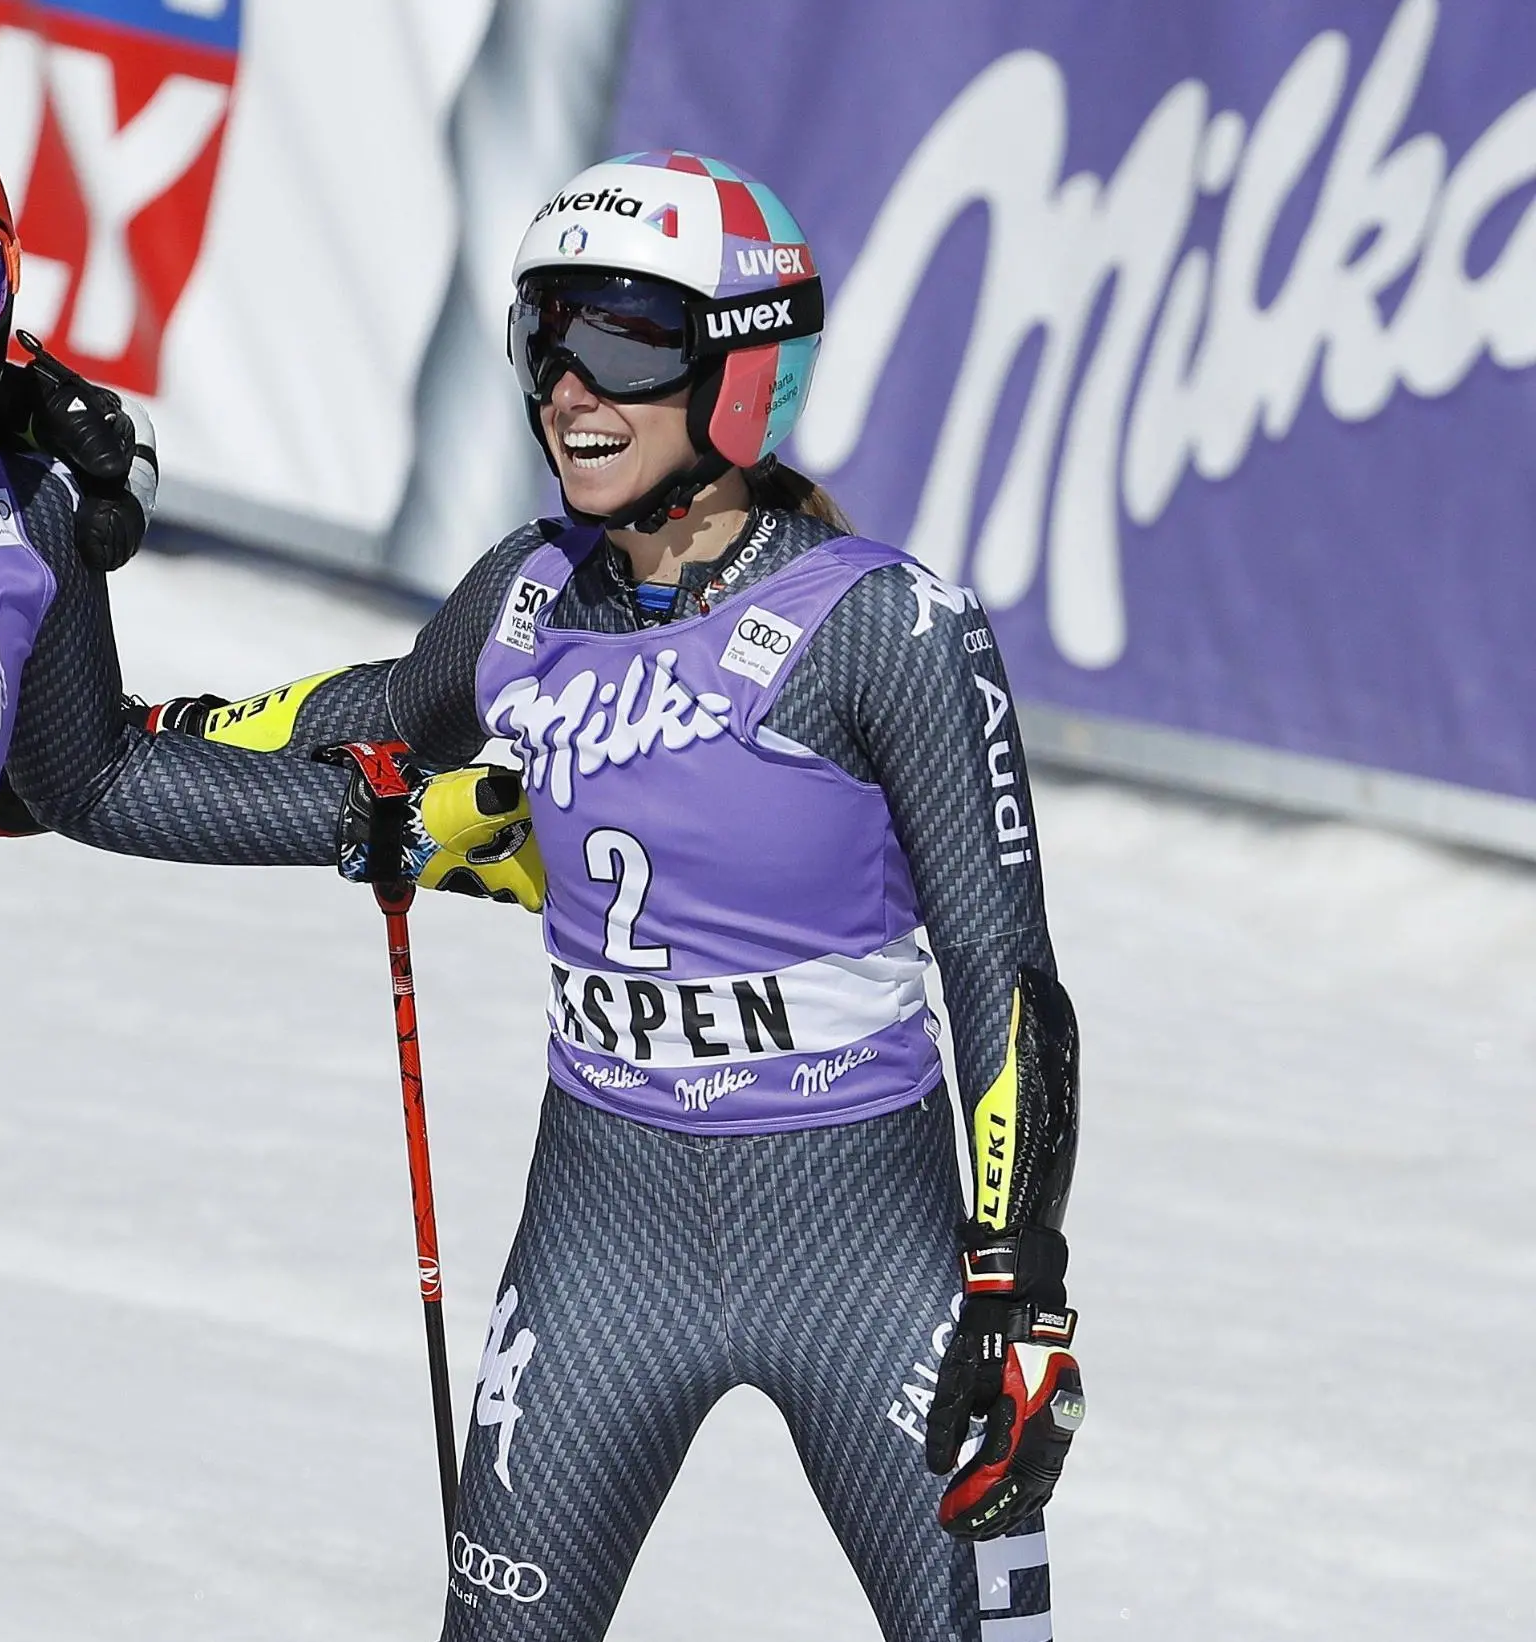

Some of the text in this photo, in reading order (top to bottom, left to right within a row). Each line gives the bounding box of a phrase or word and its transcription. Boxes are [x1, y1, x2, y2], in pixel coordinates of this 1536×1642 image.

[530, 187, 643, 227] elvetia
[735, 246, 805, 277] uvex
[705, 298, 794, 339] uvex
[765, 386, 798, 415] Bassino
[768, 372, 794, 395] Marta
[721, 515, 777, 584] BIONIC
[514, 582, 548, 615] 50
[209, 684, 292, 733] LEKI
[972, 672, 1033, 867] Audi
[583, 826, 672, 971] 2
[551, 963, 795, 1061] ASPEN
[675, 1067, 759, 1112] Milka
[791, 1047, 879, 1097] Milka
[982, 1112, 1007, 1221] LEKI
[971, 1484, 1018, 1527] LEKI
[449, 1577, 478, 1609] Audi
